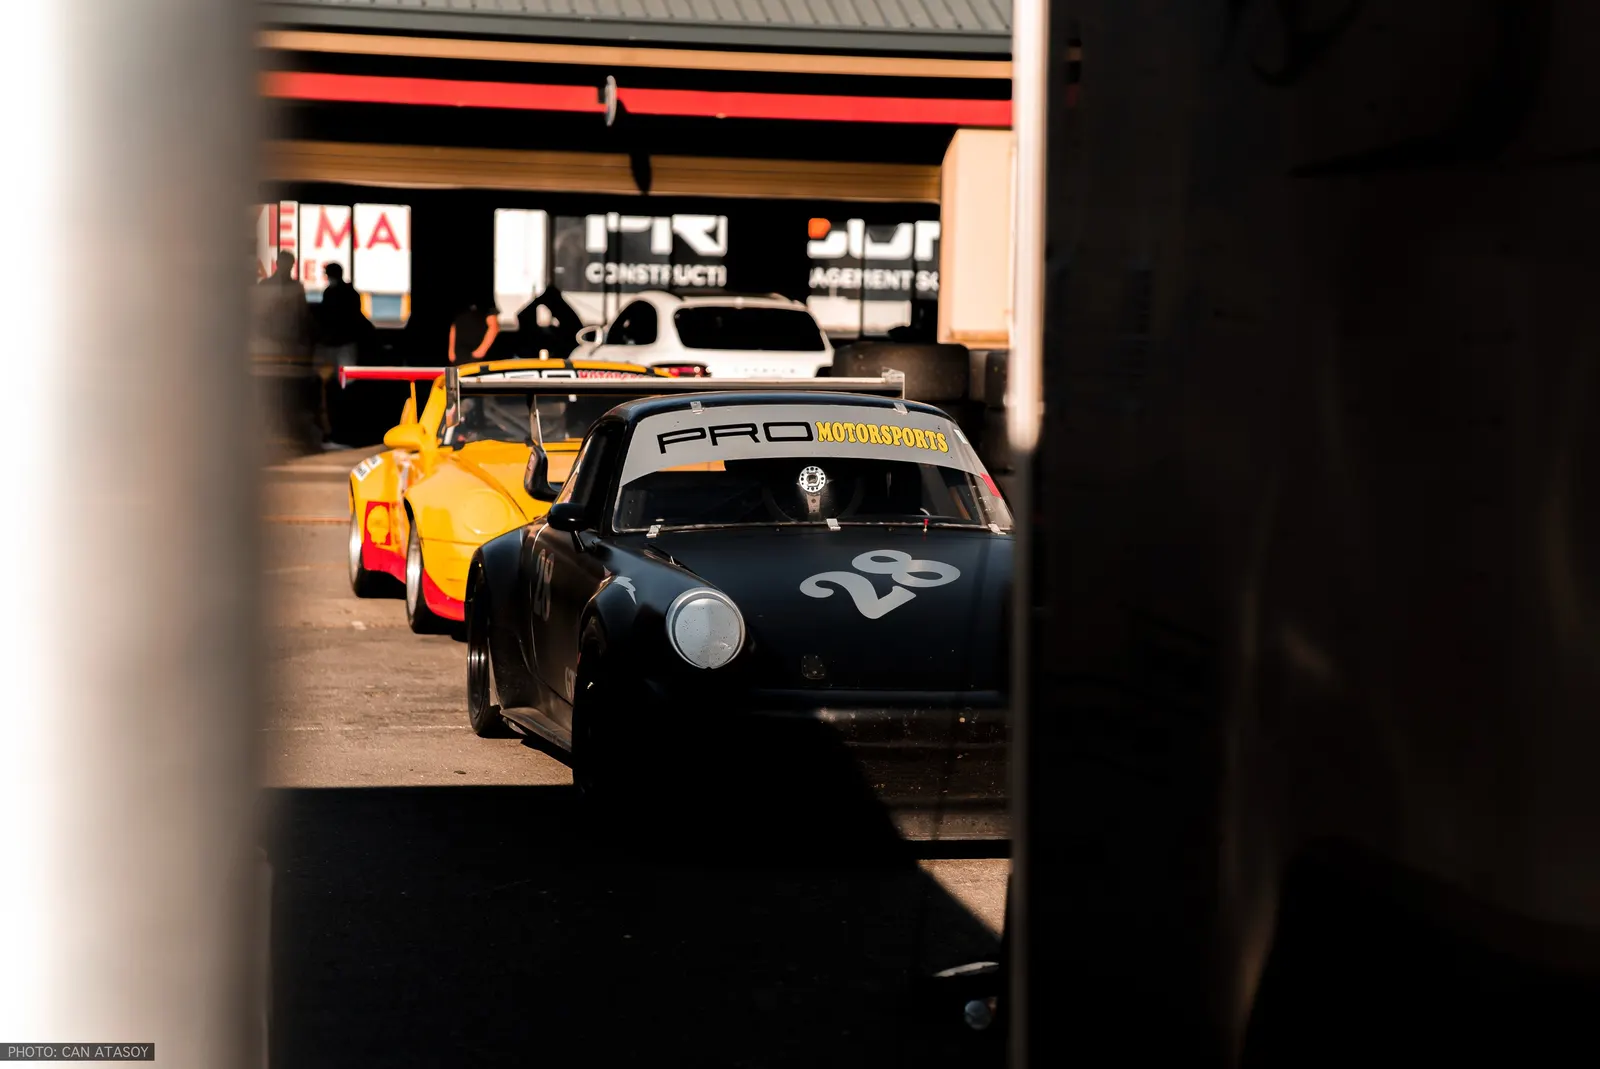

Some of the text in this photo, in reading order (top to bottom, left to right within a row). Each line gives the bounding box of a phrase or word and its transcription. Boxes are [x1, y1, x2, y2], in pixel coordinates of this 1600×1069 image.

[808, 266, 915, 291] AGEMENT
[657, 420, 950, 454] PRO MOTORSPORTS
[799, 549, 961, 620] 28
